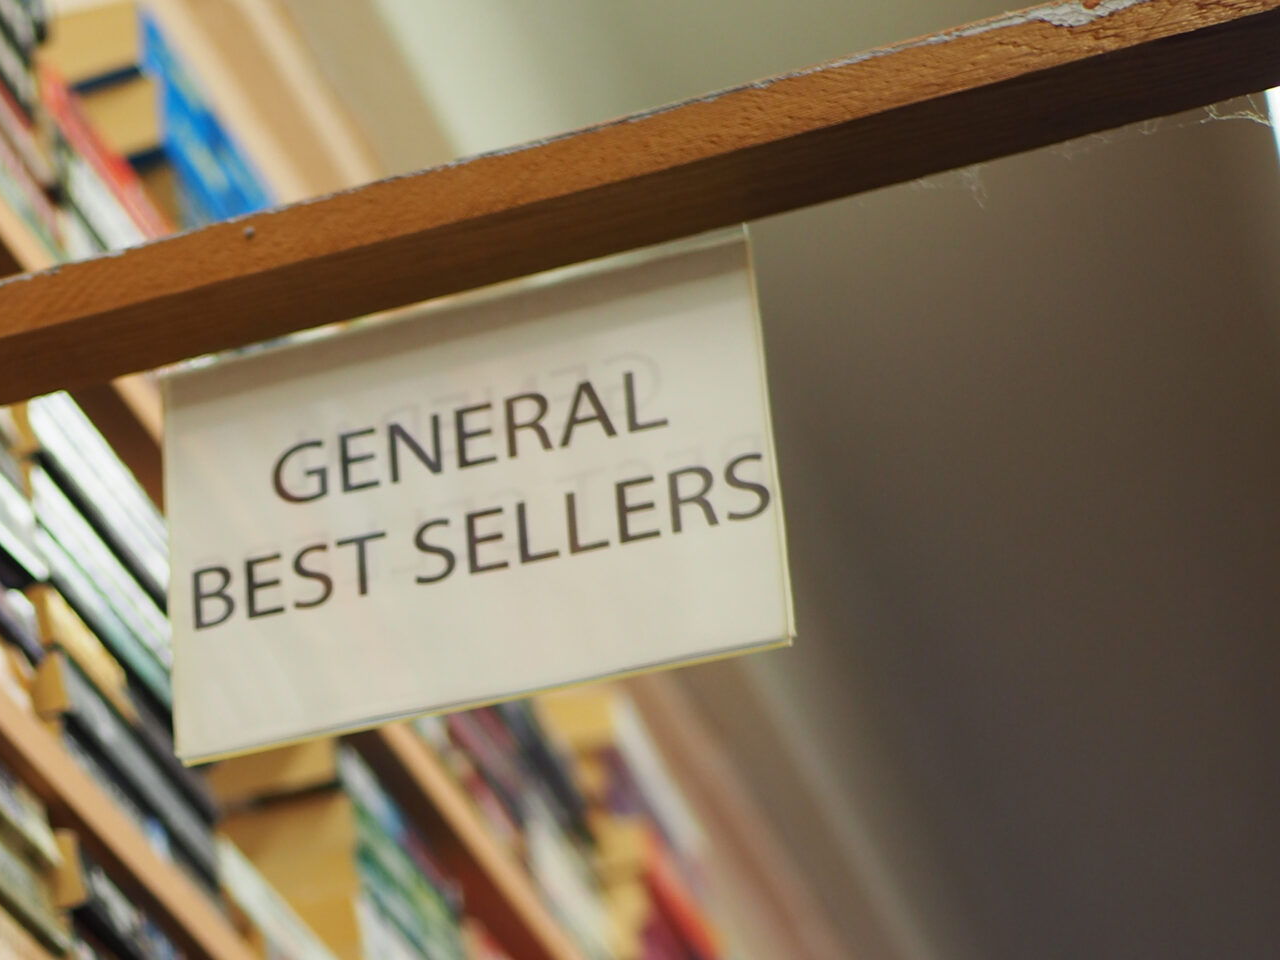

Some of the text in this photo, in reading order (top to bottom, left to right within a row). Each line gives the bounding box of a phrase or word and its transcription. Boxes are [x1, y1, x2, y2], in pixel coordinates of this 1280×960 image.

[271, 370, 668, 504] GENERAL
[191, 452, 772, 632] BEST SELLERS
